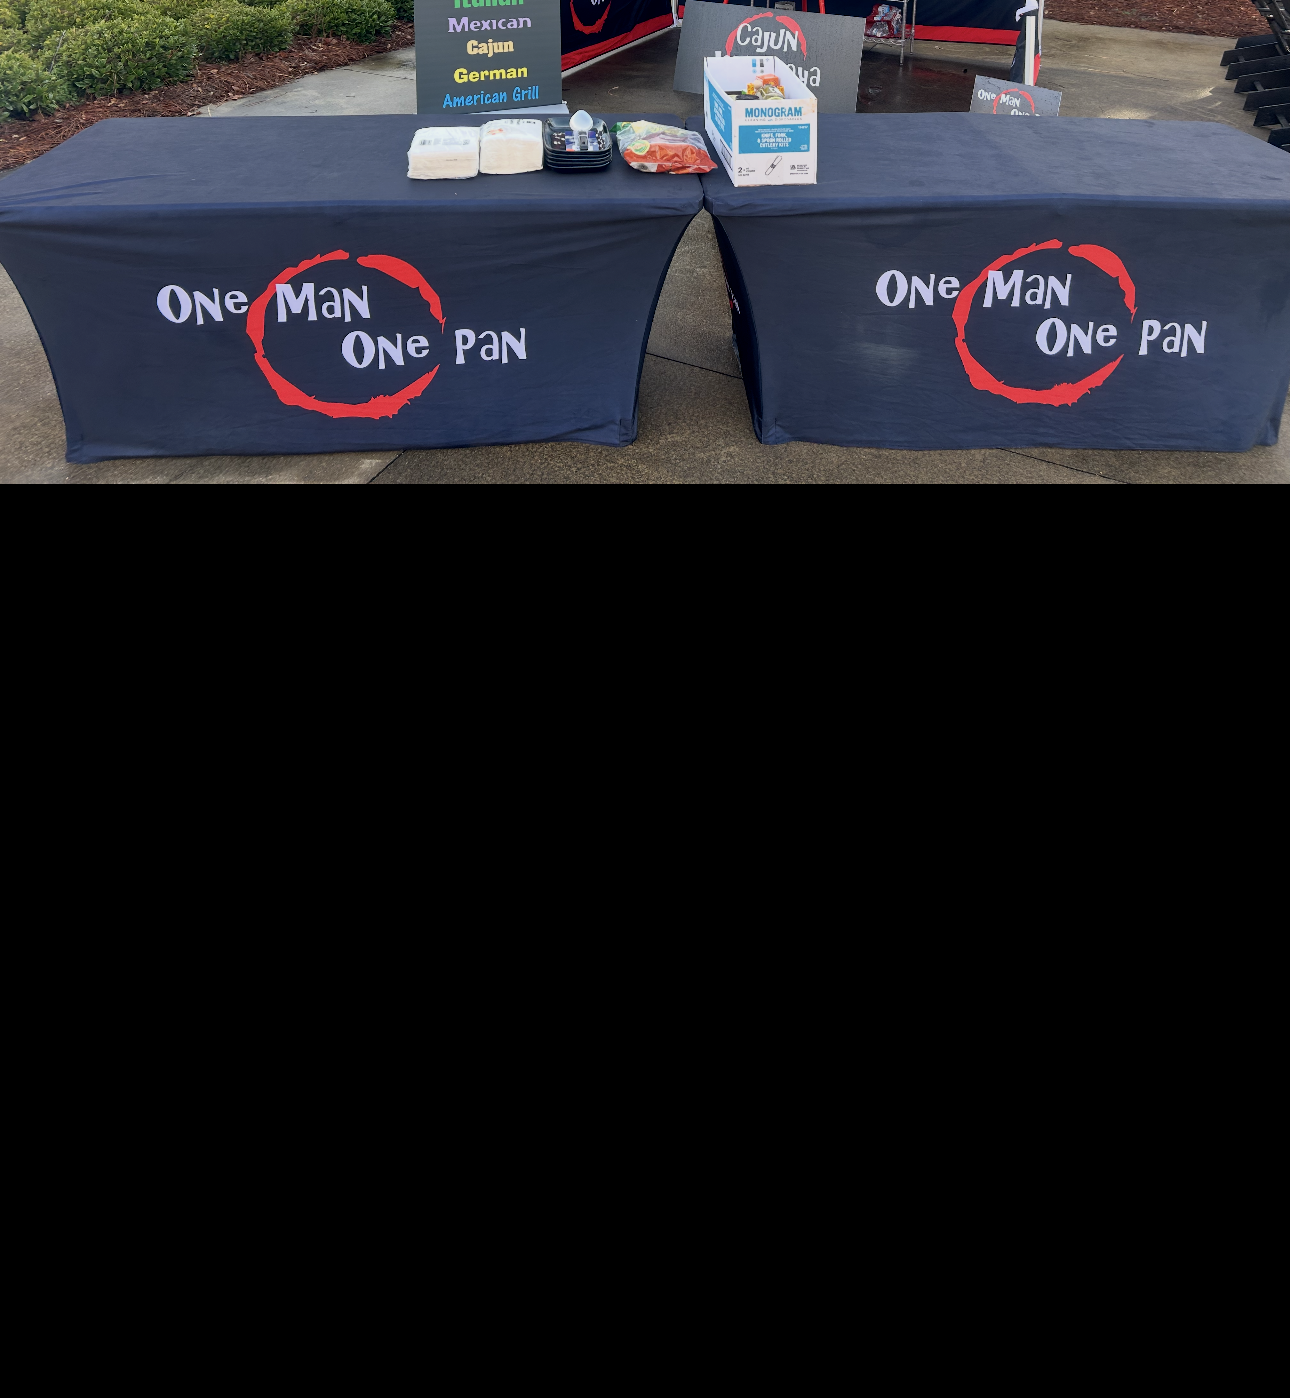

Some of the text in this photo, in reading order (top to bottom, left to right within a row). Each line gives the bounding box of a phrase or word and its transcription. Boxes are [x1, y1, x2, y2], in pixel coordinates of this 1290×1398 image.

[447, 16, 532, 33] Mexican
[466, 38, 515, 58] Cajun
[453, 67, 528, 83] German
[442, 85, 539, 108] American Grill
